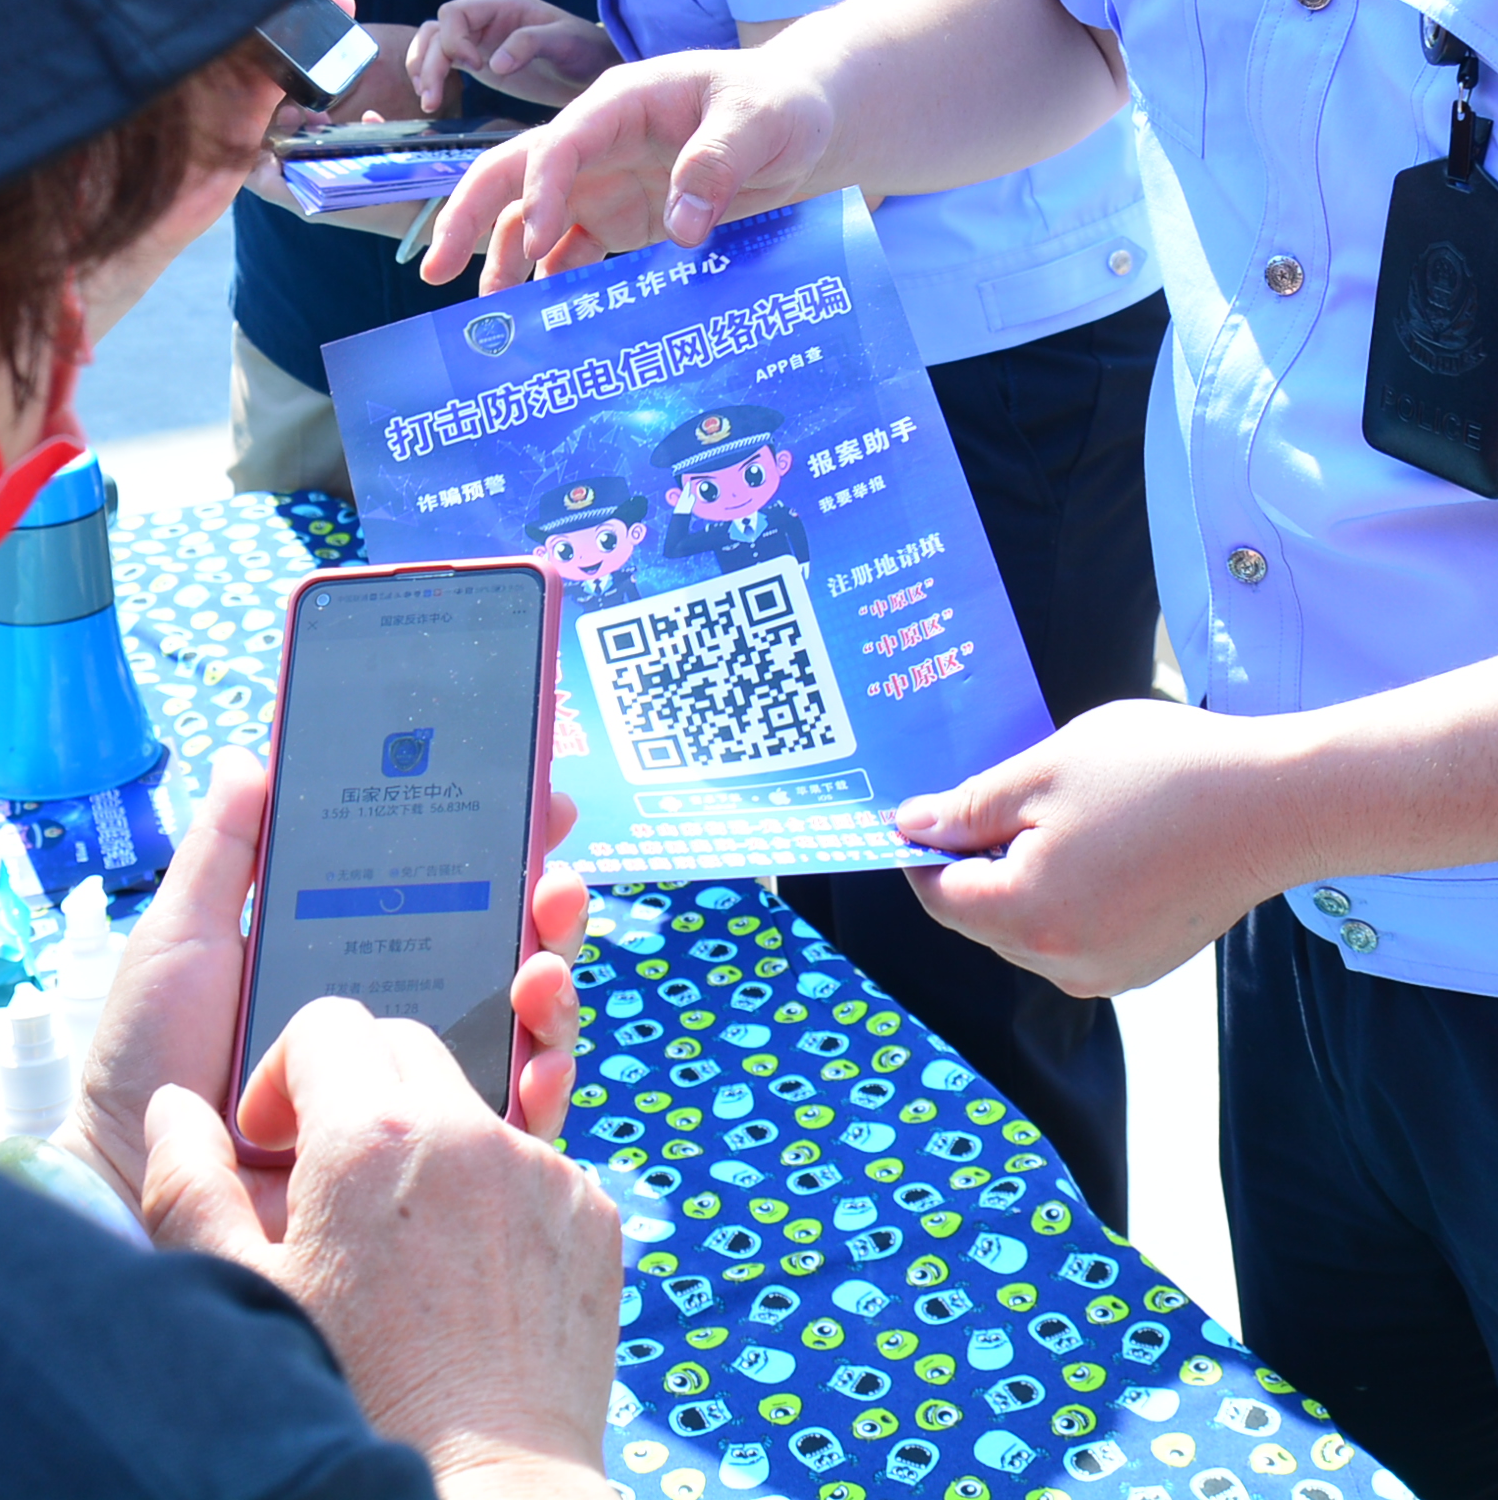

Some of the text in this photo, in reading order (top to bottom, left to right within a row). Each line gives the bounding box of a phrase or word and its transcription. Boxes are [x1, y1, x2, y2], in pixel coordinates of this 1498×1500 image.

[541, 252, 731, 332] 国家反诈中心
[384, 276, 852, 462] 打击防范电信网络诈骗
[755, 346, 824, 383] APP自查
[1381, 384, 1482, 451] POLICE
[807, 416, 918, 479] 报案助手
[416, 474, 507, 514] 诈骗预警
[818, 475, 887, 514] 我要举报
[827, 532, 946, 598] 注册地请填
[380, 612, 453, 628] 国家反诈中心
[341, 782, 464, 805] 国家反诈中心
[795, 779, 849, 797] 苹果下载
[321, 801, 481, 820] 3.5分 1.1亿次下载 56.83MB
[344, 937, 433, 956] 其他下载方式
